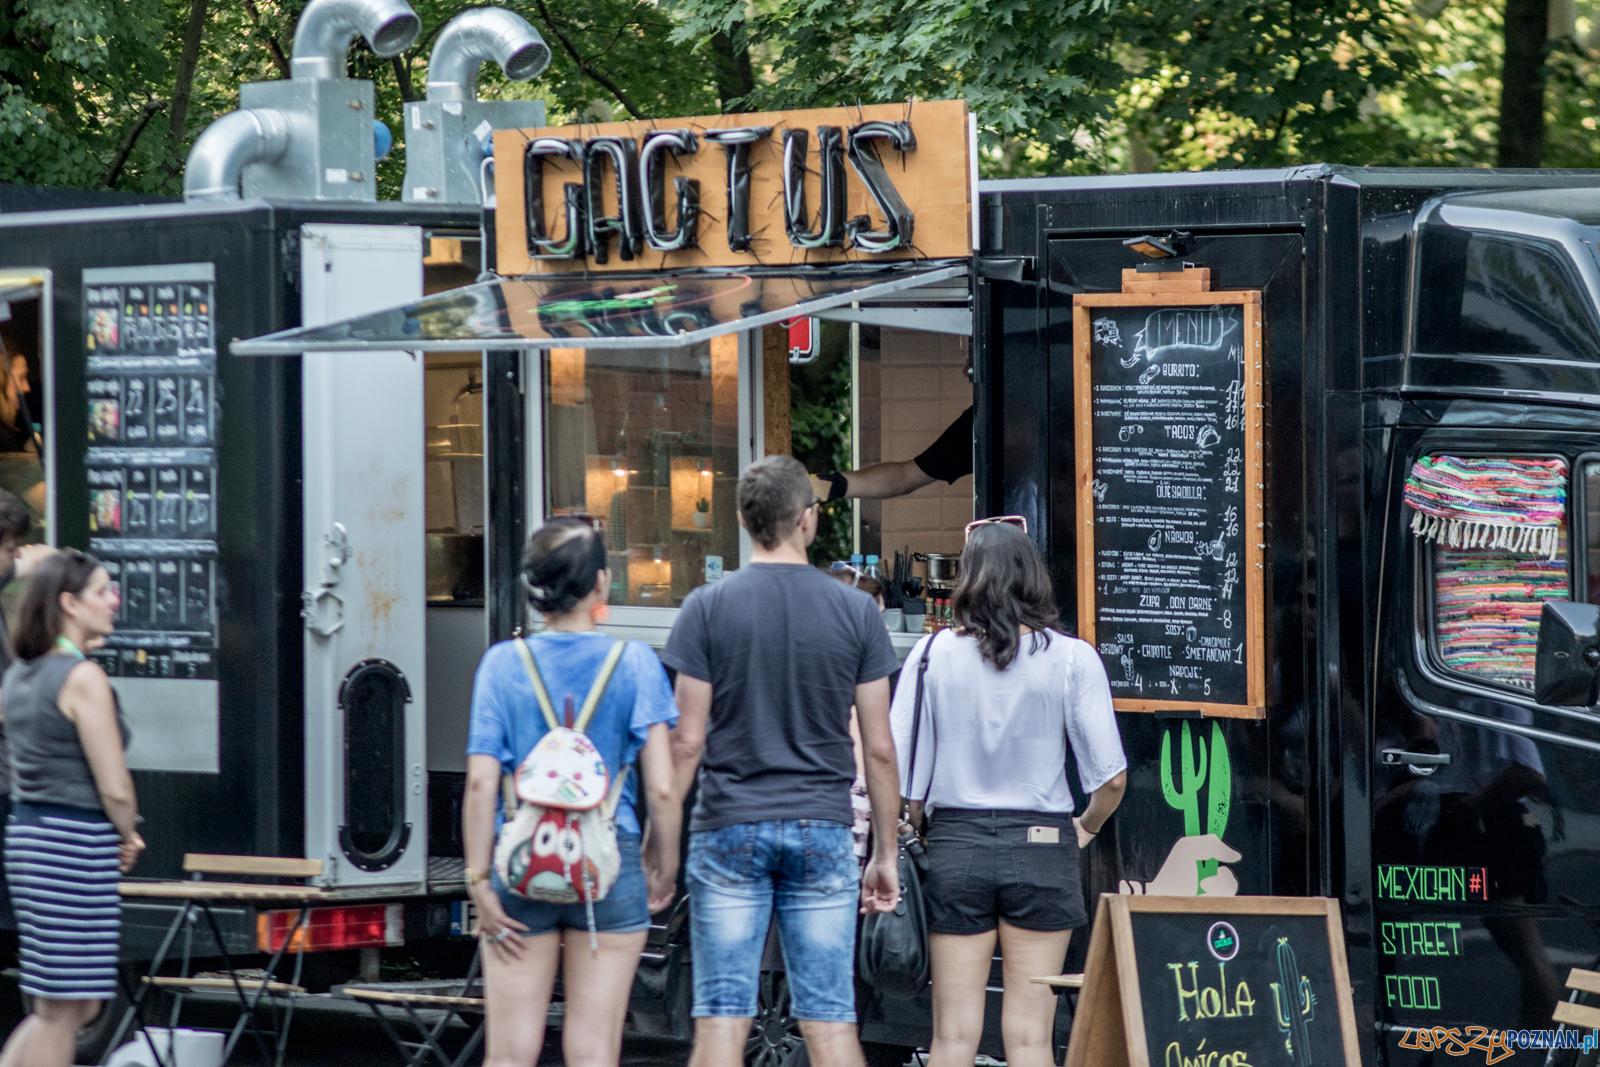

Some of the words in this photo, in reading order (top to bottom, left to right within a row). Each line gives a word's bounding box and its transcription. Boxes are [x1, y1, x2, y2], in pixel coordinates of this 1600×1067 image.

[1157, 313, 1213, 347] MENU
[1225, 414, 1238, 430] 16
[1226, 447, 1243, 463] 22
[1223, 463, 1241, 477] 22
[1223, 505, 1237, 522] 16
[1225, 523, 1239, 537] 16
[1139, 595, 1161, 608] ZUPA
[1142, 645, 1172, 660] CHIPOTLE
[1169, 665, 1203, 680] NAPOJE:
[1378, 865, 1466, 901] MEXICAN
[1382, 922, 1461, 957] STREET
[1385, 975, 1441, 1010] FOOD
